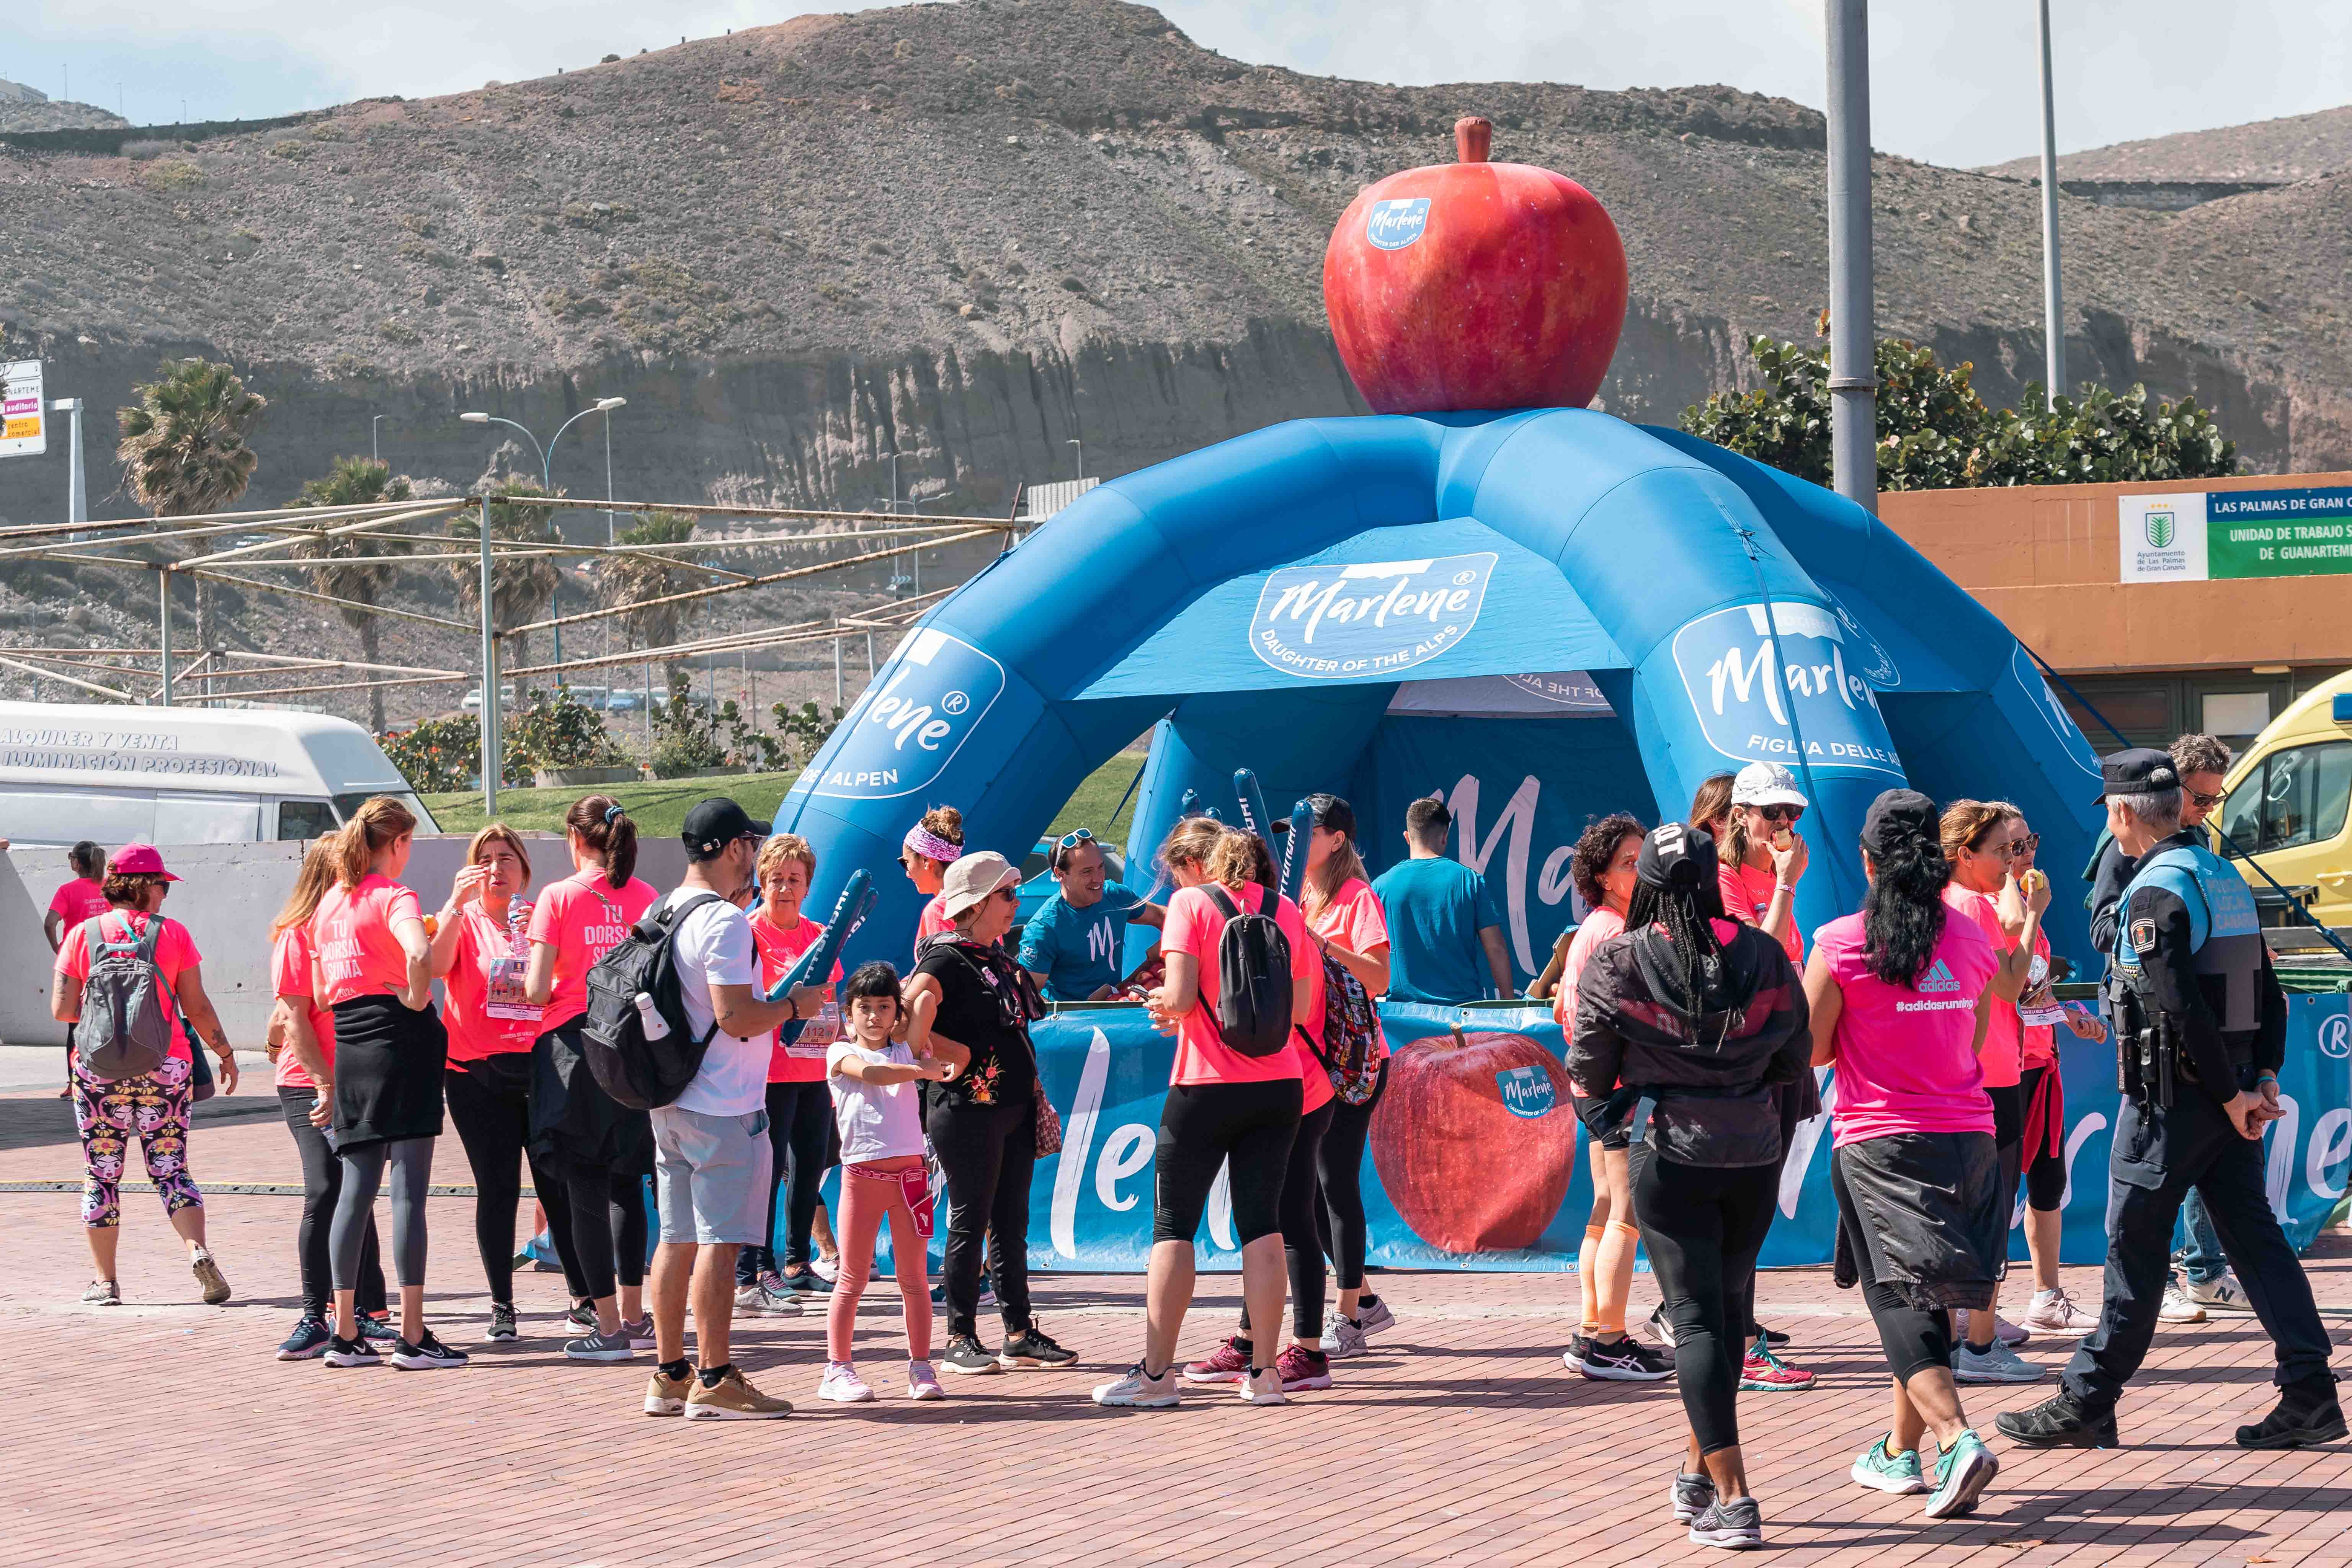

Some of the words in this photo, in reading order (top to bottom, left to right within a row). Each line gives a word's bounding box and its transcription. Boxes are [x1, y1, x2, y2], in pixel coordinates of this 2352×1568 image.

[1371, 209, 1423, 236] Marlene
[7, 402, 38, 412] auditorio
[8, 427, 40, 437] comercial
[2215, 502, 2237, 513] LAS
[2241, 500, 2287, 512] PALMAS
[2291, 499, 2306, 510] DE
[2310, 498, 2343, 508] GRAN
[2230, 528, 2274, 542] UNIDAD
[2277, 527, 2292, 540] DE
[2294, 525, 2343, 539] TRABAJO
[2260, 547, 2275, 560] DE
[1269, 576, 1472, 644] Marlene
[1261, 628, 1337, 672] DAUGHTER
[1342, 659, 1369, 672] OF
[1374, 650, 1410, 668] THE
[1415, 624, 1458, 657] ALPS
[0, 728, 93, 747] ALQUILER
[98, 732, 113, 747] Y
[117, 732, 177, 750] VENTA
[1747, 734, 1824, 755] FIGLIA
[1833, 743, 1887, 763] DELLE
[2, 751, 136, 771] ILUMINACIÓN
[829, 768, 898, 787] ALPEN
[602, 904, 622, 923] TU
[332, 919, 347, 938] TU
[321, 936, 365, 962] DORSAL
[327, 959, 363, 981] SUMA
[1919, 980, 1960, 993] adidas
[1896, 998, 1973, 1012] #adidasrunning
[1504, 1078, 1552, 1107] Marlene
[1508, 1102, 1534, 1116] DAUGHTER
